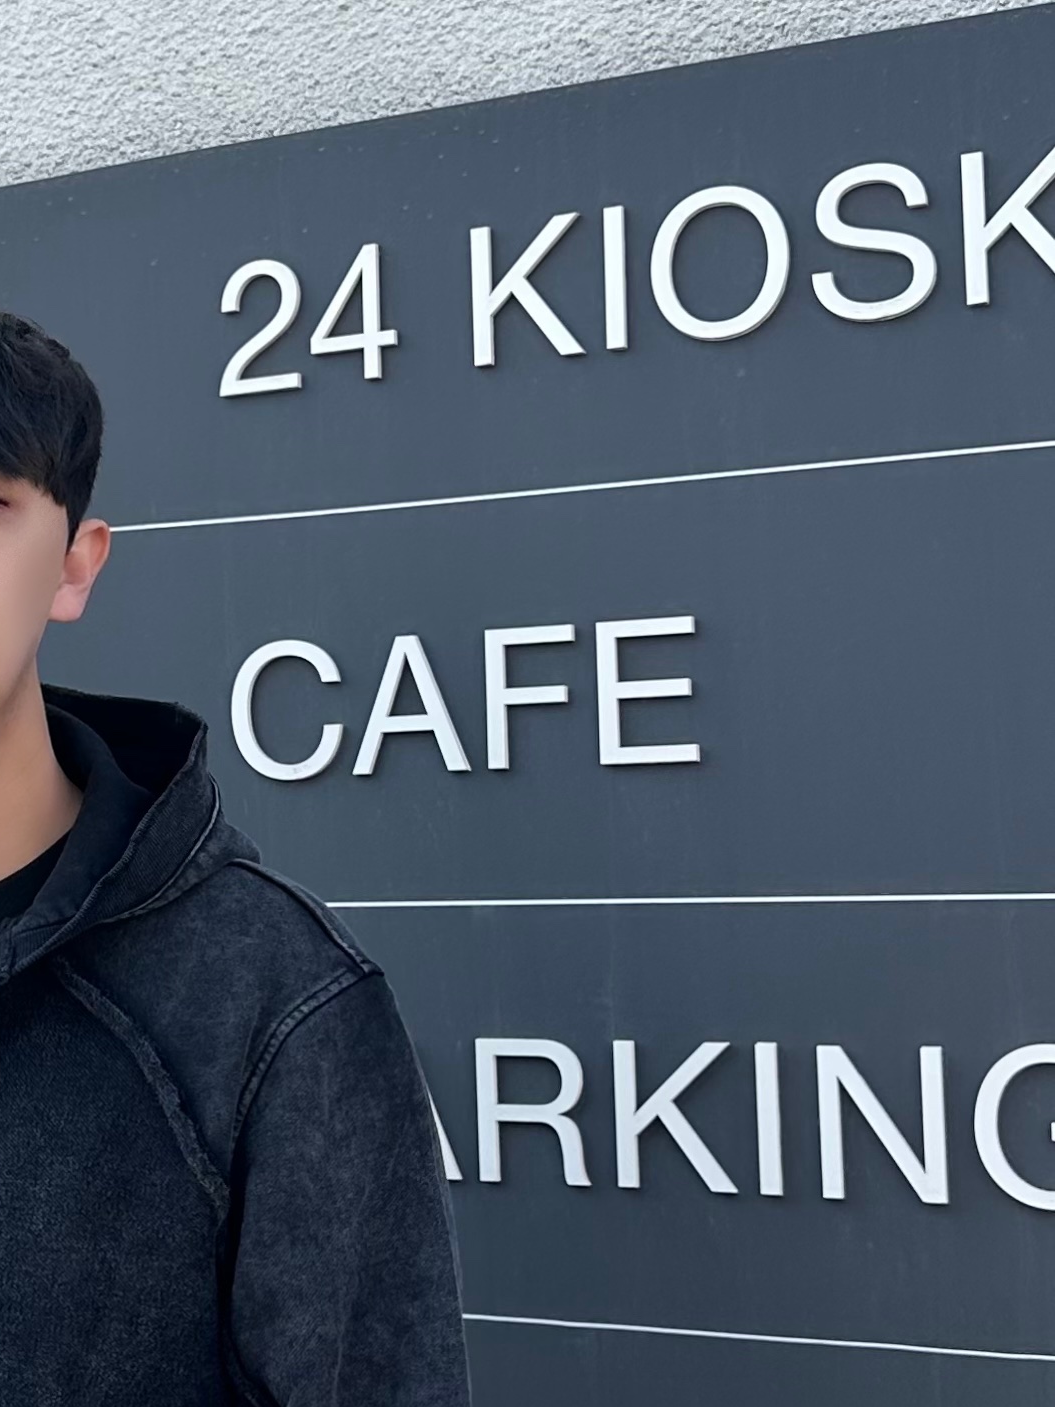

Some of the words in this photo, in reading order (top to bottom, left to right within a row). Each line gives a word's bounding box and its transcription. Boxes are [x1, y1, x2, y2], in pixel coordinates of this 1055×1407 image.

[218, 242, 399, 398] 24
[468, 146, 1055, 368] KIOSK
[229, 614, 702, 782] CAFE
